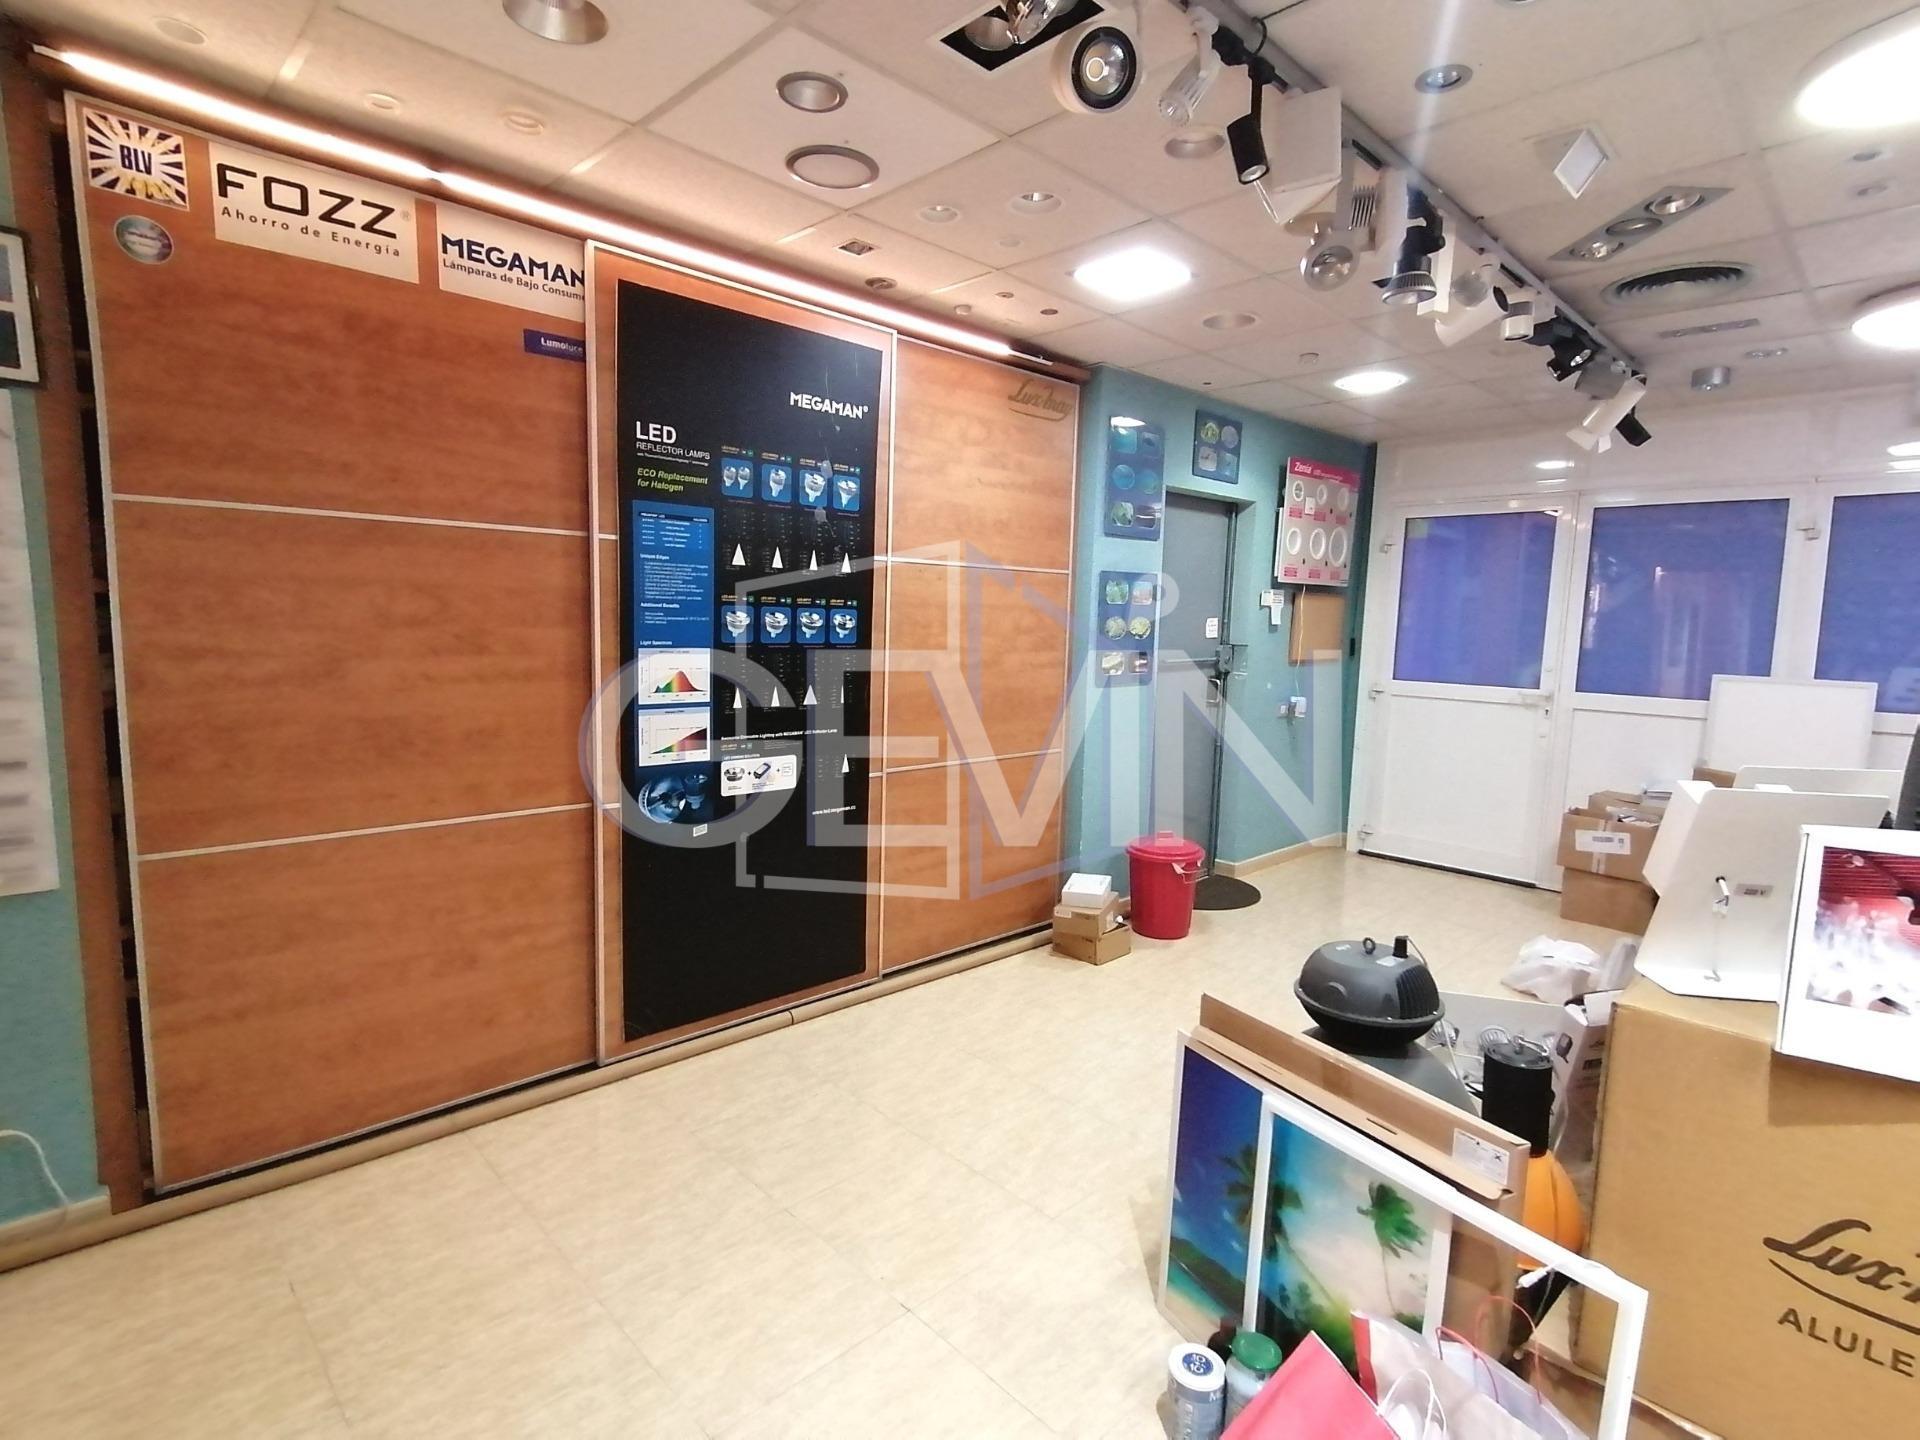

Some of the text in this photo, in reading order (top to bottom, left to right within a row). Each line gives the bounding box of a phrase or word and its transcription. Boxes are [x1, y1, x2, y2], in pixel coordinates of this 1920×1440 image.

[119, 144, 153, 176] BLV
[221, 206, 290, 231] Ahorro
[300, 225, 321, 239] de
[441, 233, 585, 288] MEGAMAN
[500, 273, 514, 285] de
[516, 277, 540, 291] Bajo
[636, 420, 677, 444] LED
[636, 441, 683, 456] REFLECTOR
[684, 449, 711, 460] LAMPS
[637, 467, 708, 485] ECO Replacement
[637, 478, 684, 492] for Halogen
